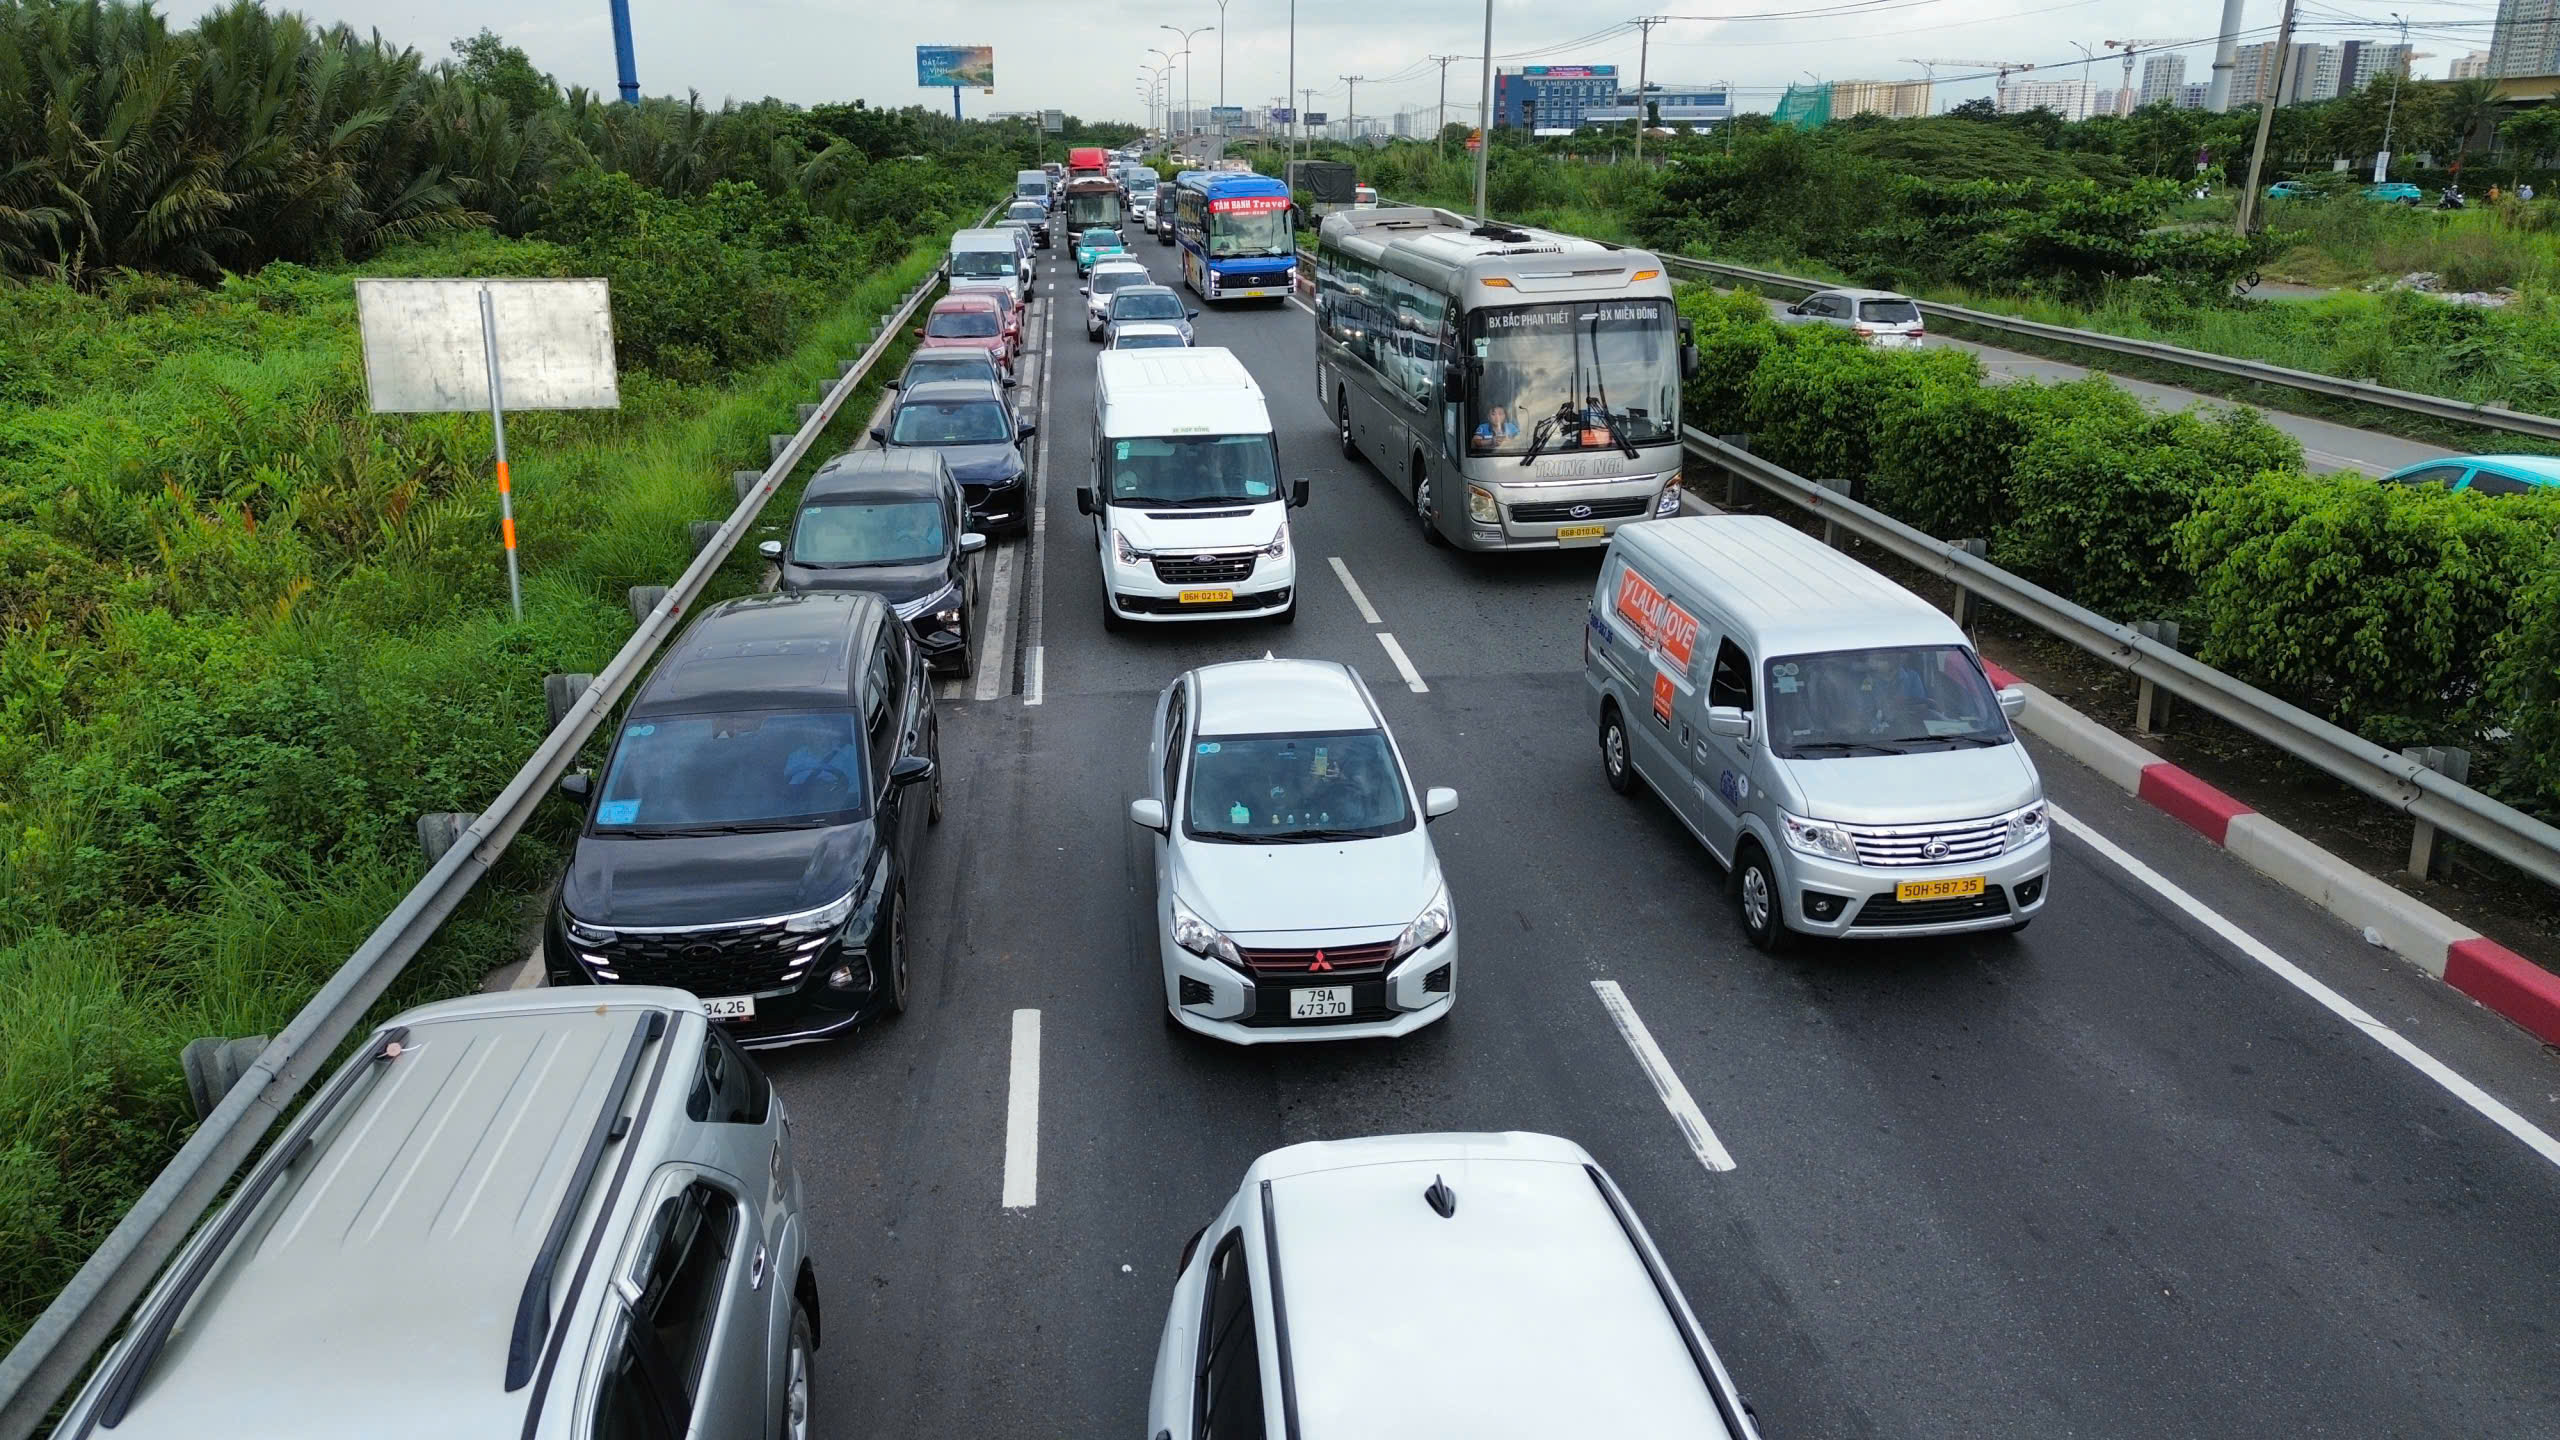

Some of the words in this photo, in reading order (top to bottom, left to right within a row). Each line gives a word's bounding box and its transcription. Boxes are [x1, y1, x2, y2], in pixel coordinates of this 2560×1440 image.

[1214, 200, 1230, 210] TÂM
[1253, 200, 1286, 209] Travel
[1489, 316, 1502, 328] BX
[1502, 312, 1520, 328] BẮC
[1521, 313, 1544, 326] PHAN
[1545, 308, 1569, 325] THIẾT
[1600, 309, 1613, 321] BX
[1614, 305, 1635, 320] MIỀN
[1636, 306, 1658, 320] ĐÔNG
[1535, 459, 1586, 478] TRUNG
[1593, 457, 1625, 475] NGA
[1631, 582, 1696, 650] LALAMOVE
[1904, 880, 1977, 897] 50H-587.35
[1308, 990, 1335, 1002] 79A
[703, 1000, 746, 1016] 84.26
[1297, 1002, 1346, 1016] 473.70
